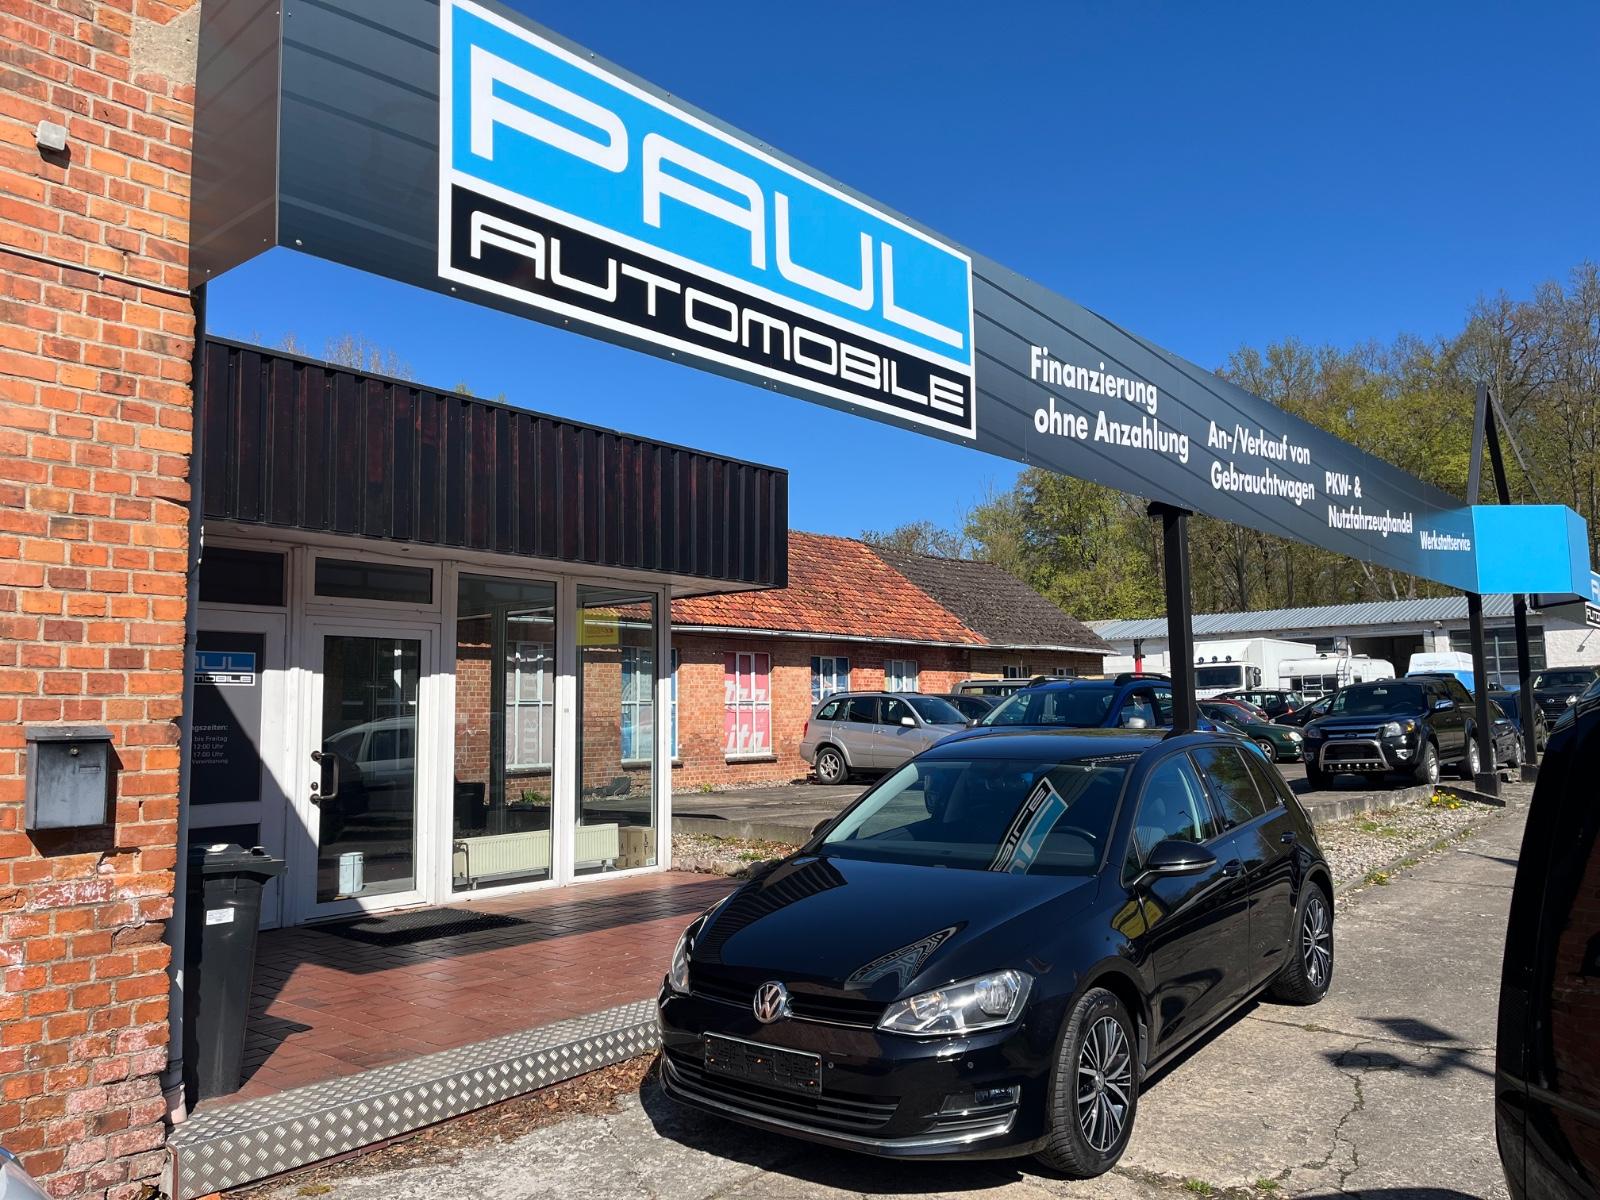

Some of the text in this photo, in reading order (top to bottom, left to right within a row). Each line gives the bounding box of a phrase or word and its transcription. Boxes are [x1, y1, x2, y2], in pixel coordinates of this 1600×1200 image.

[471, 44, 963, 350] PAUL
[471, 210, 963, 416] AUTOMOBILE
[1031, 345, 1157, 415] Finanzierung
[1034, 397, 1189, 463] ohne Anzahlung
[1208, 420, 1310, 465] An-/Verkauf von
[1211, 461, 1315, 506] Gebrauchtwagen
[1325, 471, 1362, 498] PKW- &
[1328, 505, 1413, 538] Nutzfahrzeughandel
[1420, 530, 1471, 551] Werkstattservice
